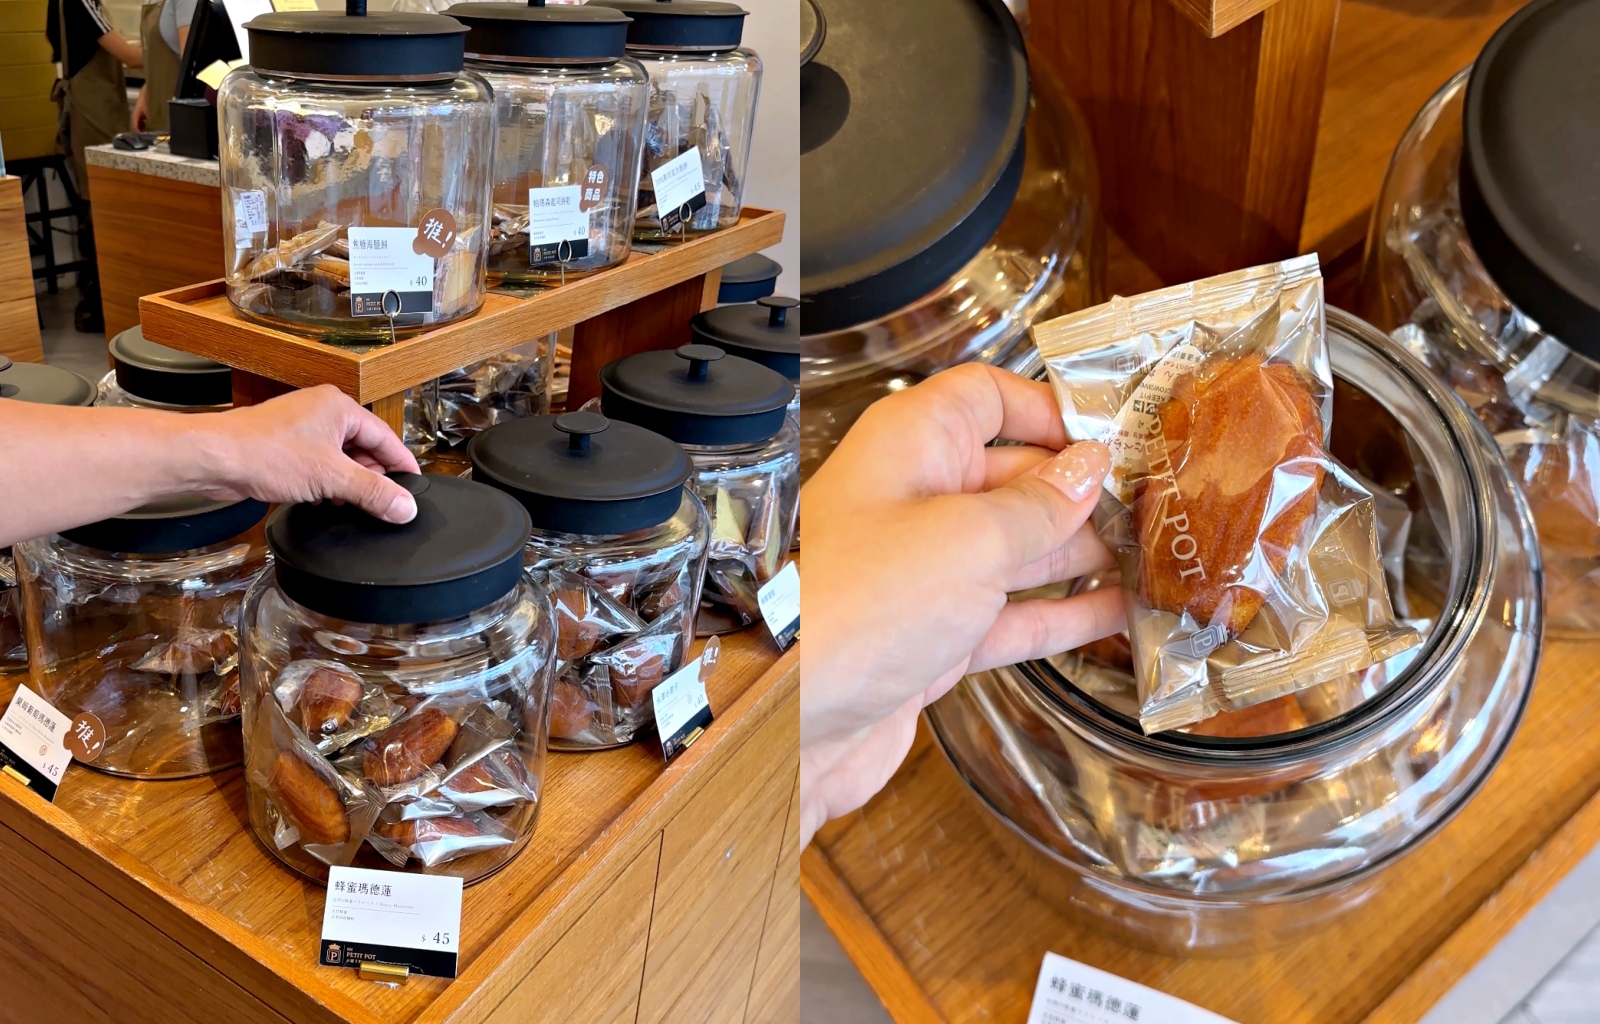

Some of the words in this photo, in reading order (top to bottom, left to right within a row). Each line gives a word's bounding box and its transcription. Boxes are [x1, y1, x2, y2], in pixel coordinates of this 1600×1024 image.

[588, 170, 604, 184] 特色
[584, 187, 601, 202] 商品
[578, 225, 586, 236] 40
[415, 275, 428, 287] 40
[1144, 412, 1181, 502] PETIT
[1163, 511, 1207, 581] POT
[47, 763, 60, 777] 45
[334, 880, 393, 897] 蜂蜜瑪德蓮
[420, 934, 426, 942] $
[432, 932, 451, 945] 45
[346, 951, 363, 959] PETIT
[1050, 974, 1142, 1022] 蜂蜜瑪德蓮
